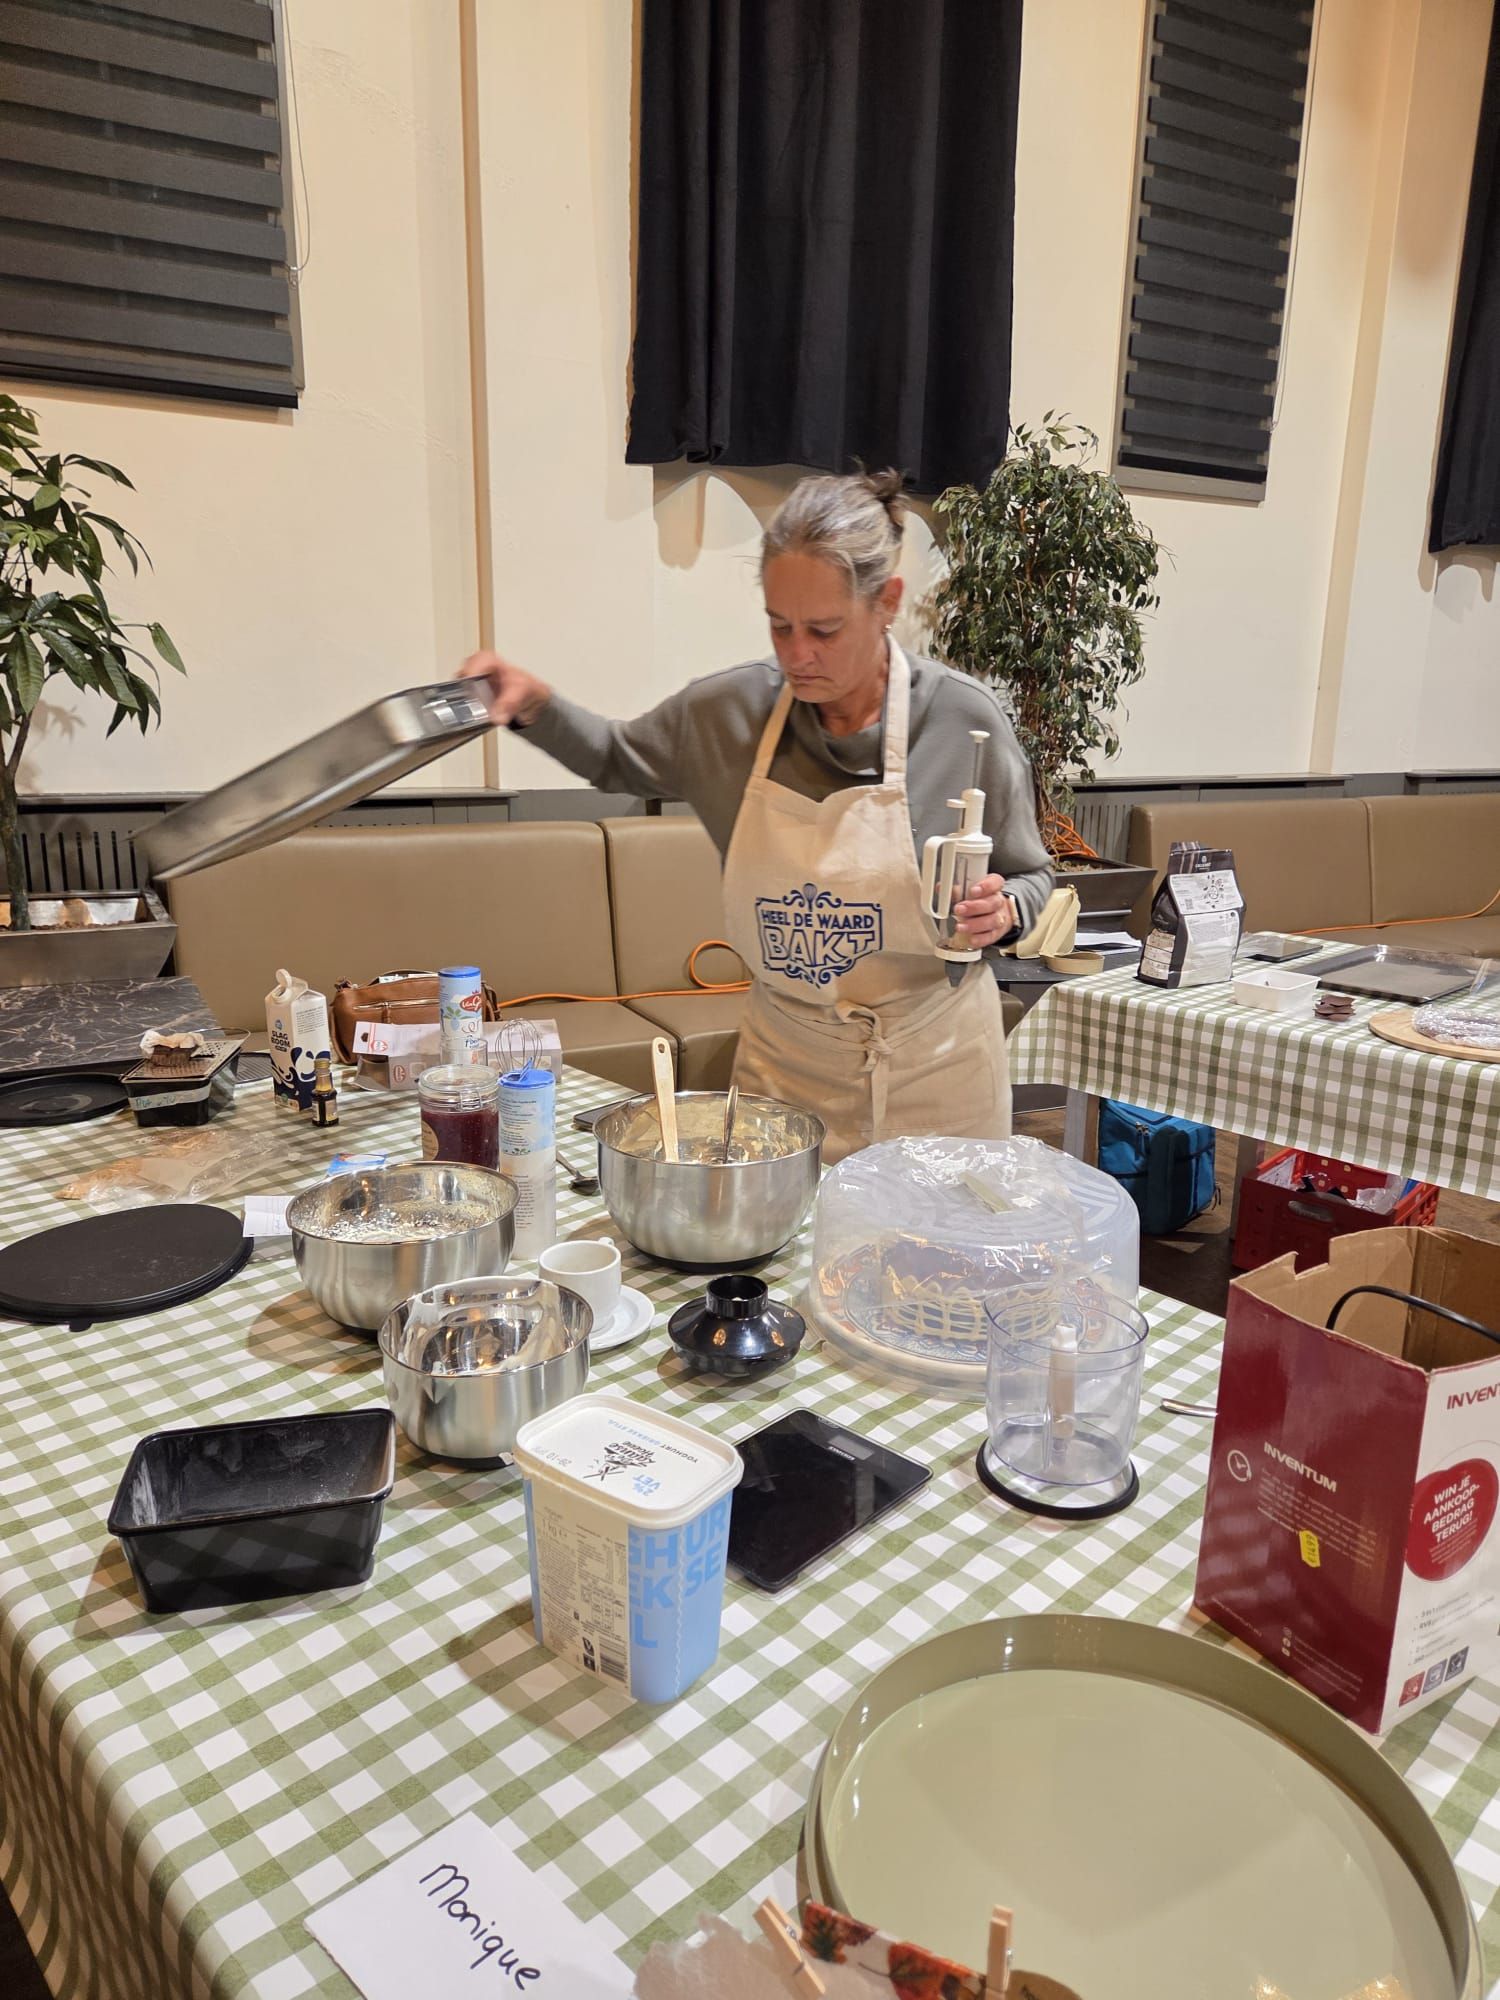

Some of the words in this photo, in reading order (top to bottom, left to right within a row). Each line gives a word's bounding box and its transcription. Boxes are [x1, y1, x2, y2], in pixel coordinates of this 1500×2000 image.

[761, 909, 791, 926] HEEL
[794, 912, 813, 927] DE
[817, 914, 875, 930] WAARD
[763, 925, 875, 967] BAKT
[271, 1030, 288, 1040] SLAG
[271, 1037, 290, 1048] ROOM
[1446, 1382, 1500, 1410] INVEN
[660, 1443, 698, 1464] YOGHURT
[1263, 1441, 1338, 1493] INVENTUM
[1423, 1483, 1481, 1525] AANKOOP-
[1434, 1483, 1458, 1505] WIN
[1458, 1474, 1472, 1492] JE
[1431, 1497, 1475, 1533] BEDRAG
[1435, 1510, 1474, 1543] TERUG!
[419, 1863, 541, 1990] Monique
